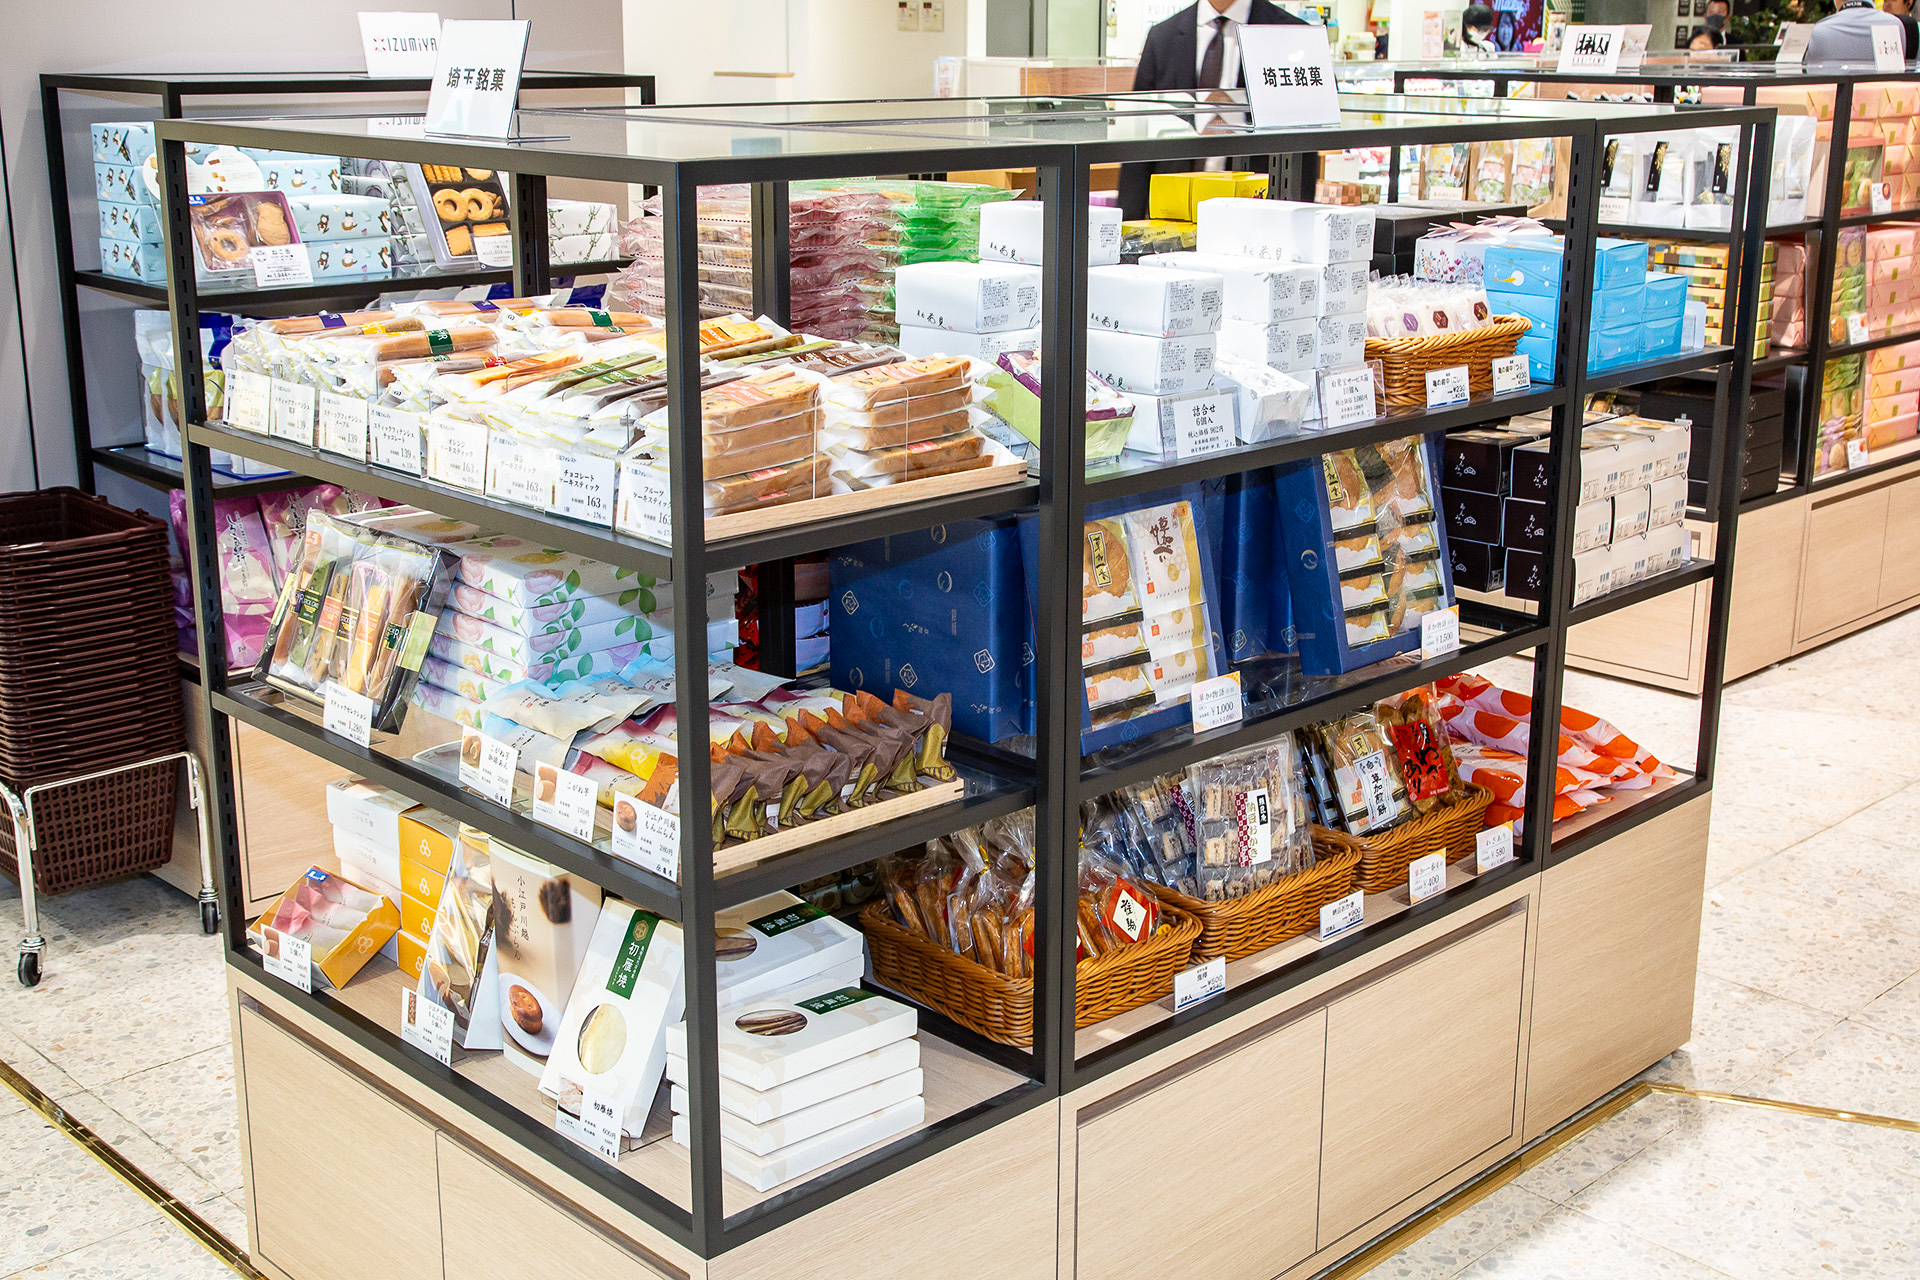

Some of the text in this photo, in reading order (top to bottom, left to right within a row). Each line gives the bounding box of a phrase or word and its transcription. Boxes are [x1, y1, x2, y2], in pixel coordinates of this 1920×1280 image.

[447, 67, 506, 91] 埼玉銘菓
[1263, 66, 1324, 88] 埼玉銘菓
[1192, 403, 1216, 417] 詰合せ
[1196, 416, 1213, 427] 6個入
[383, 433, 405, 443] チョコレート
[448, 439, 465, 448] オレンジ
[441, 445, 473, 458] ケーキスティック
[563, 469, 594, 482] チョコレート
[559, 477, 600, 491] ケーキスティック
[643, 486, 664, 497] フルーツ
[566, 781, 590, 797] こがね芋
[644, 809, 677, 831] 小江戸川越
[645, 820, 676, 841] もんぶらん
[1246, 802, 1258, 858] 納豆おかき
[517, 875, 530, 941] 小江戸川越
